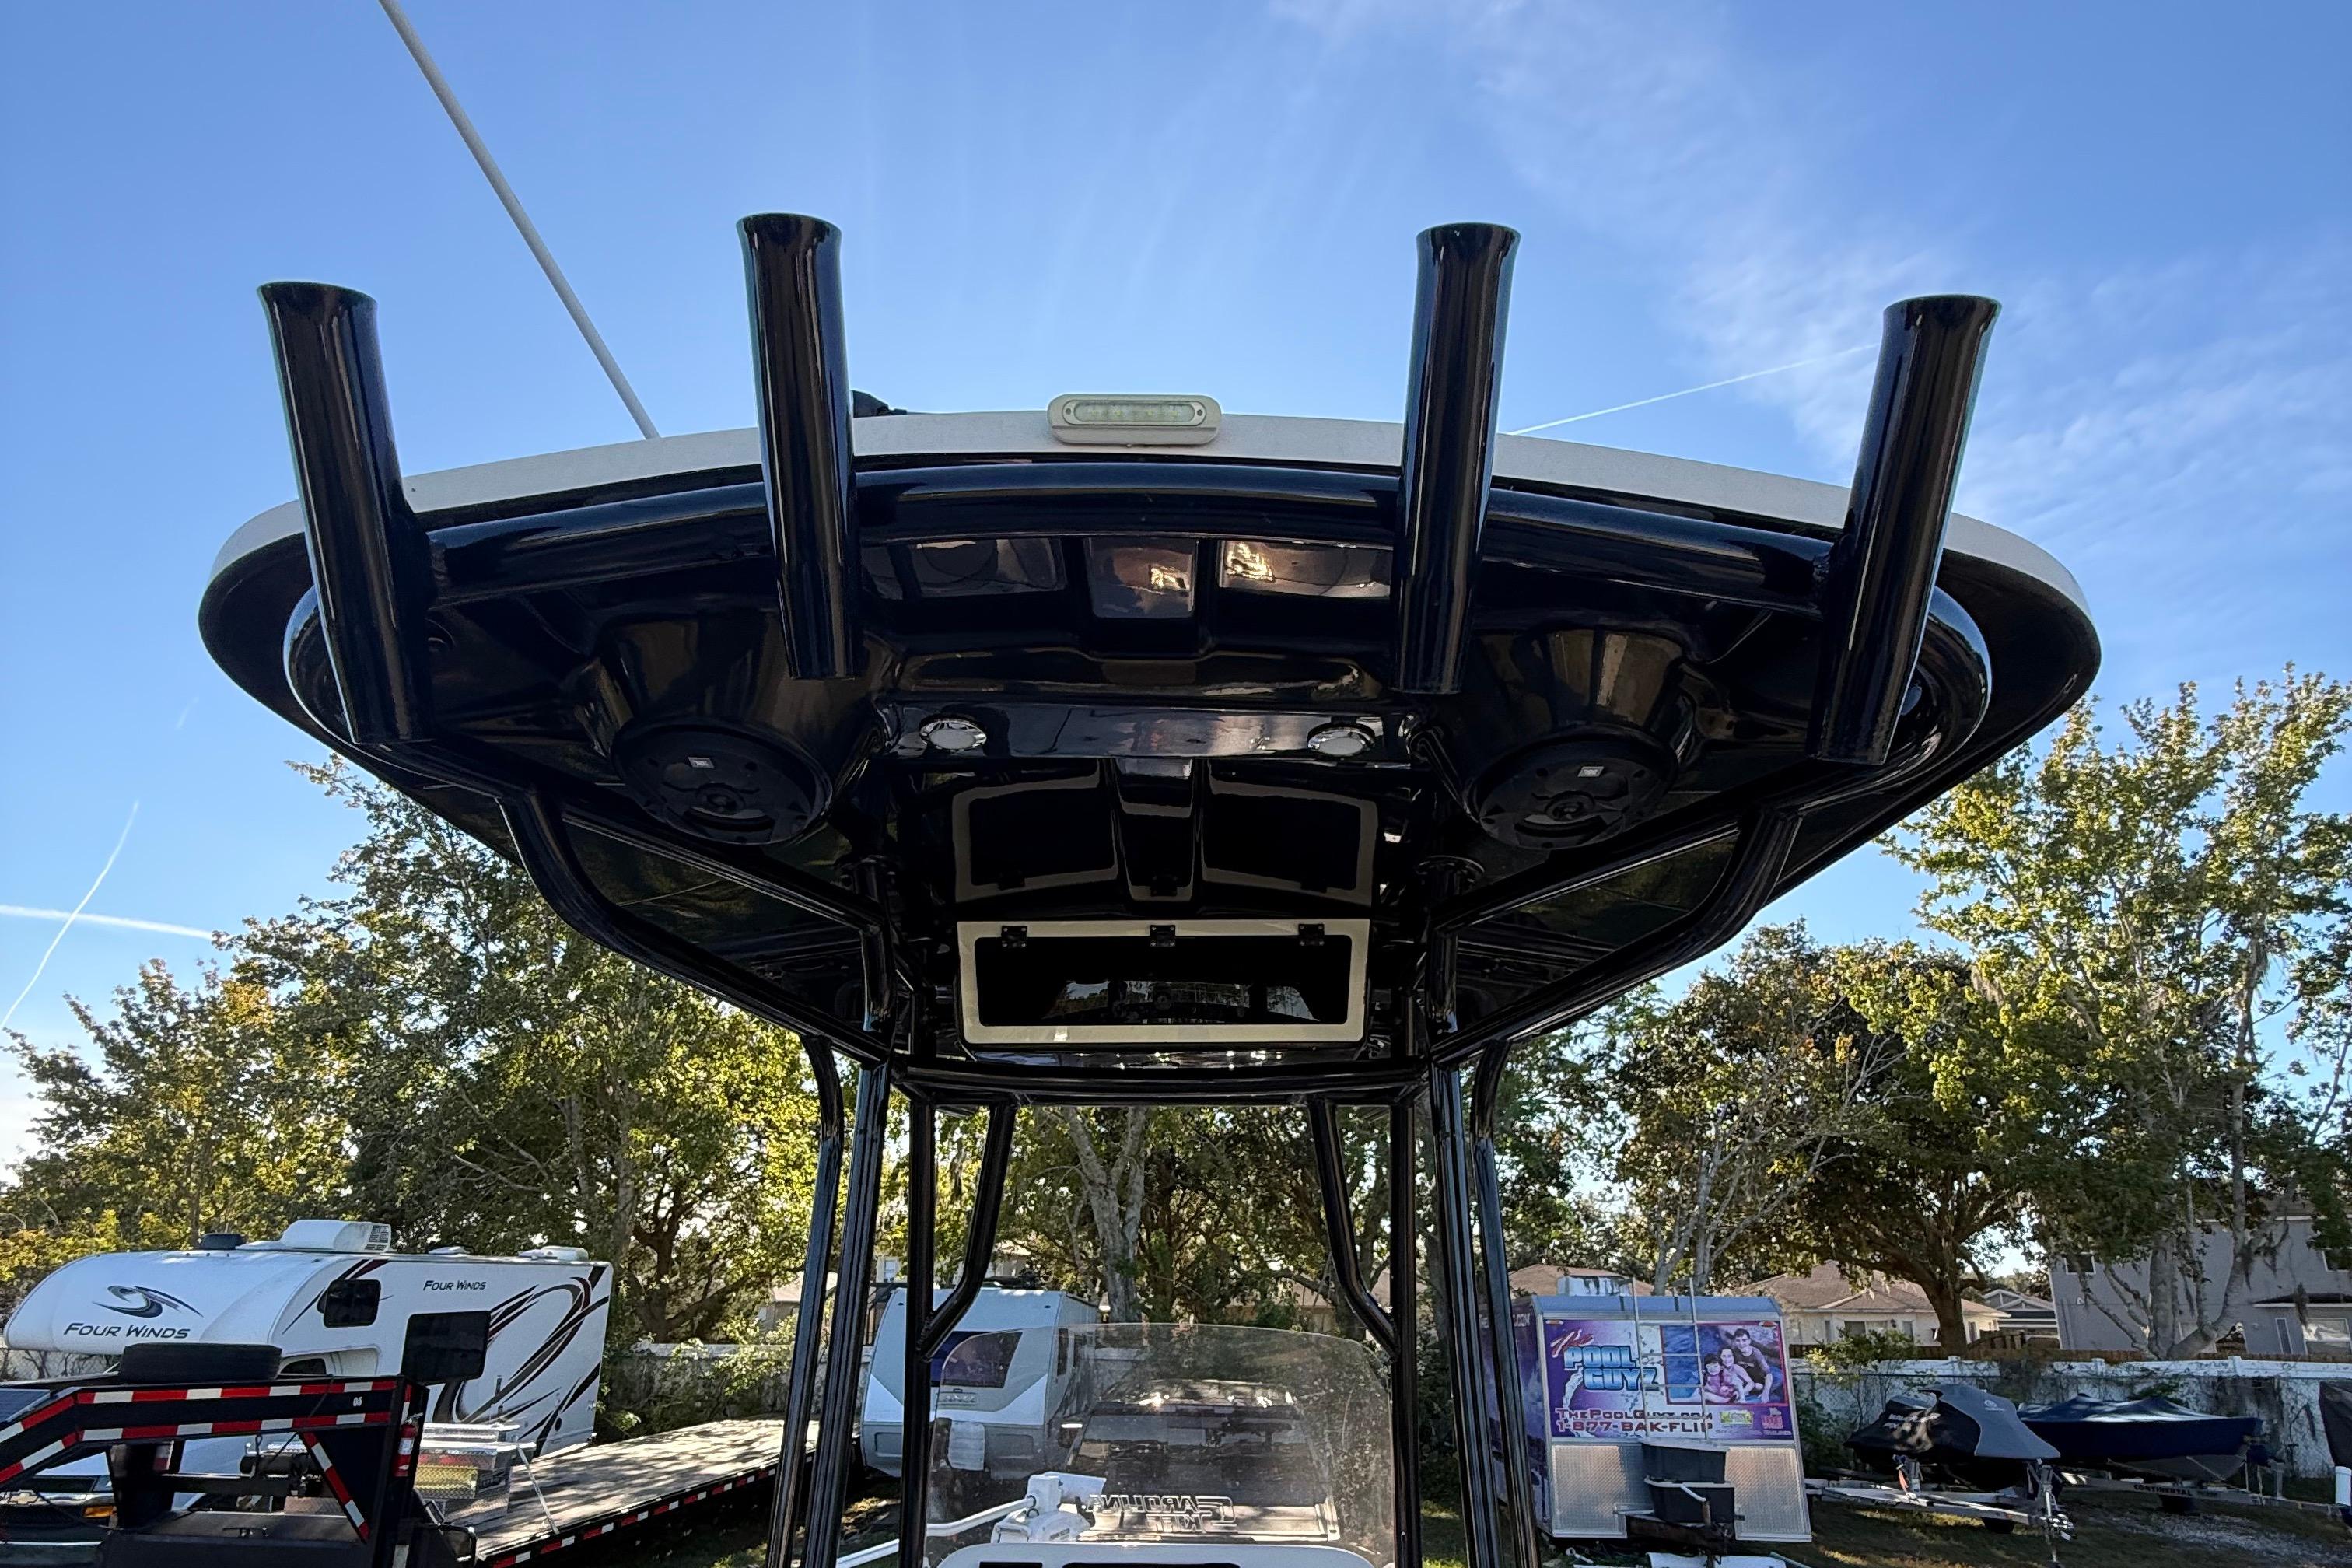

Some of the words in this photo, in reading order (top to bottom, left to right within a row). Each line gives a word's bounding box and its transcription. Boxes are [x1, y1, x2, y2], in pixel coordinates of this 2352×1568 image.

[423, 1280, 454, 1291] FOUR
[457, 1280, 487, 1290] WINDS
[64, 1323, 121, 1337] FOUR
[126, 1325, 191, 1339] WINDS
[1563, 1345, 1637, 1370] POOL
[1583, 1367, 1660, 1391] GUYZ
[352, 1397, 362, 1407] 05
[2133, 1484, 2193, 1496] CONTINENTAL
